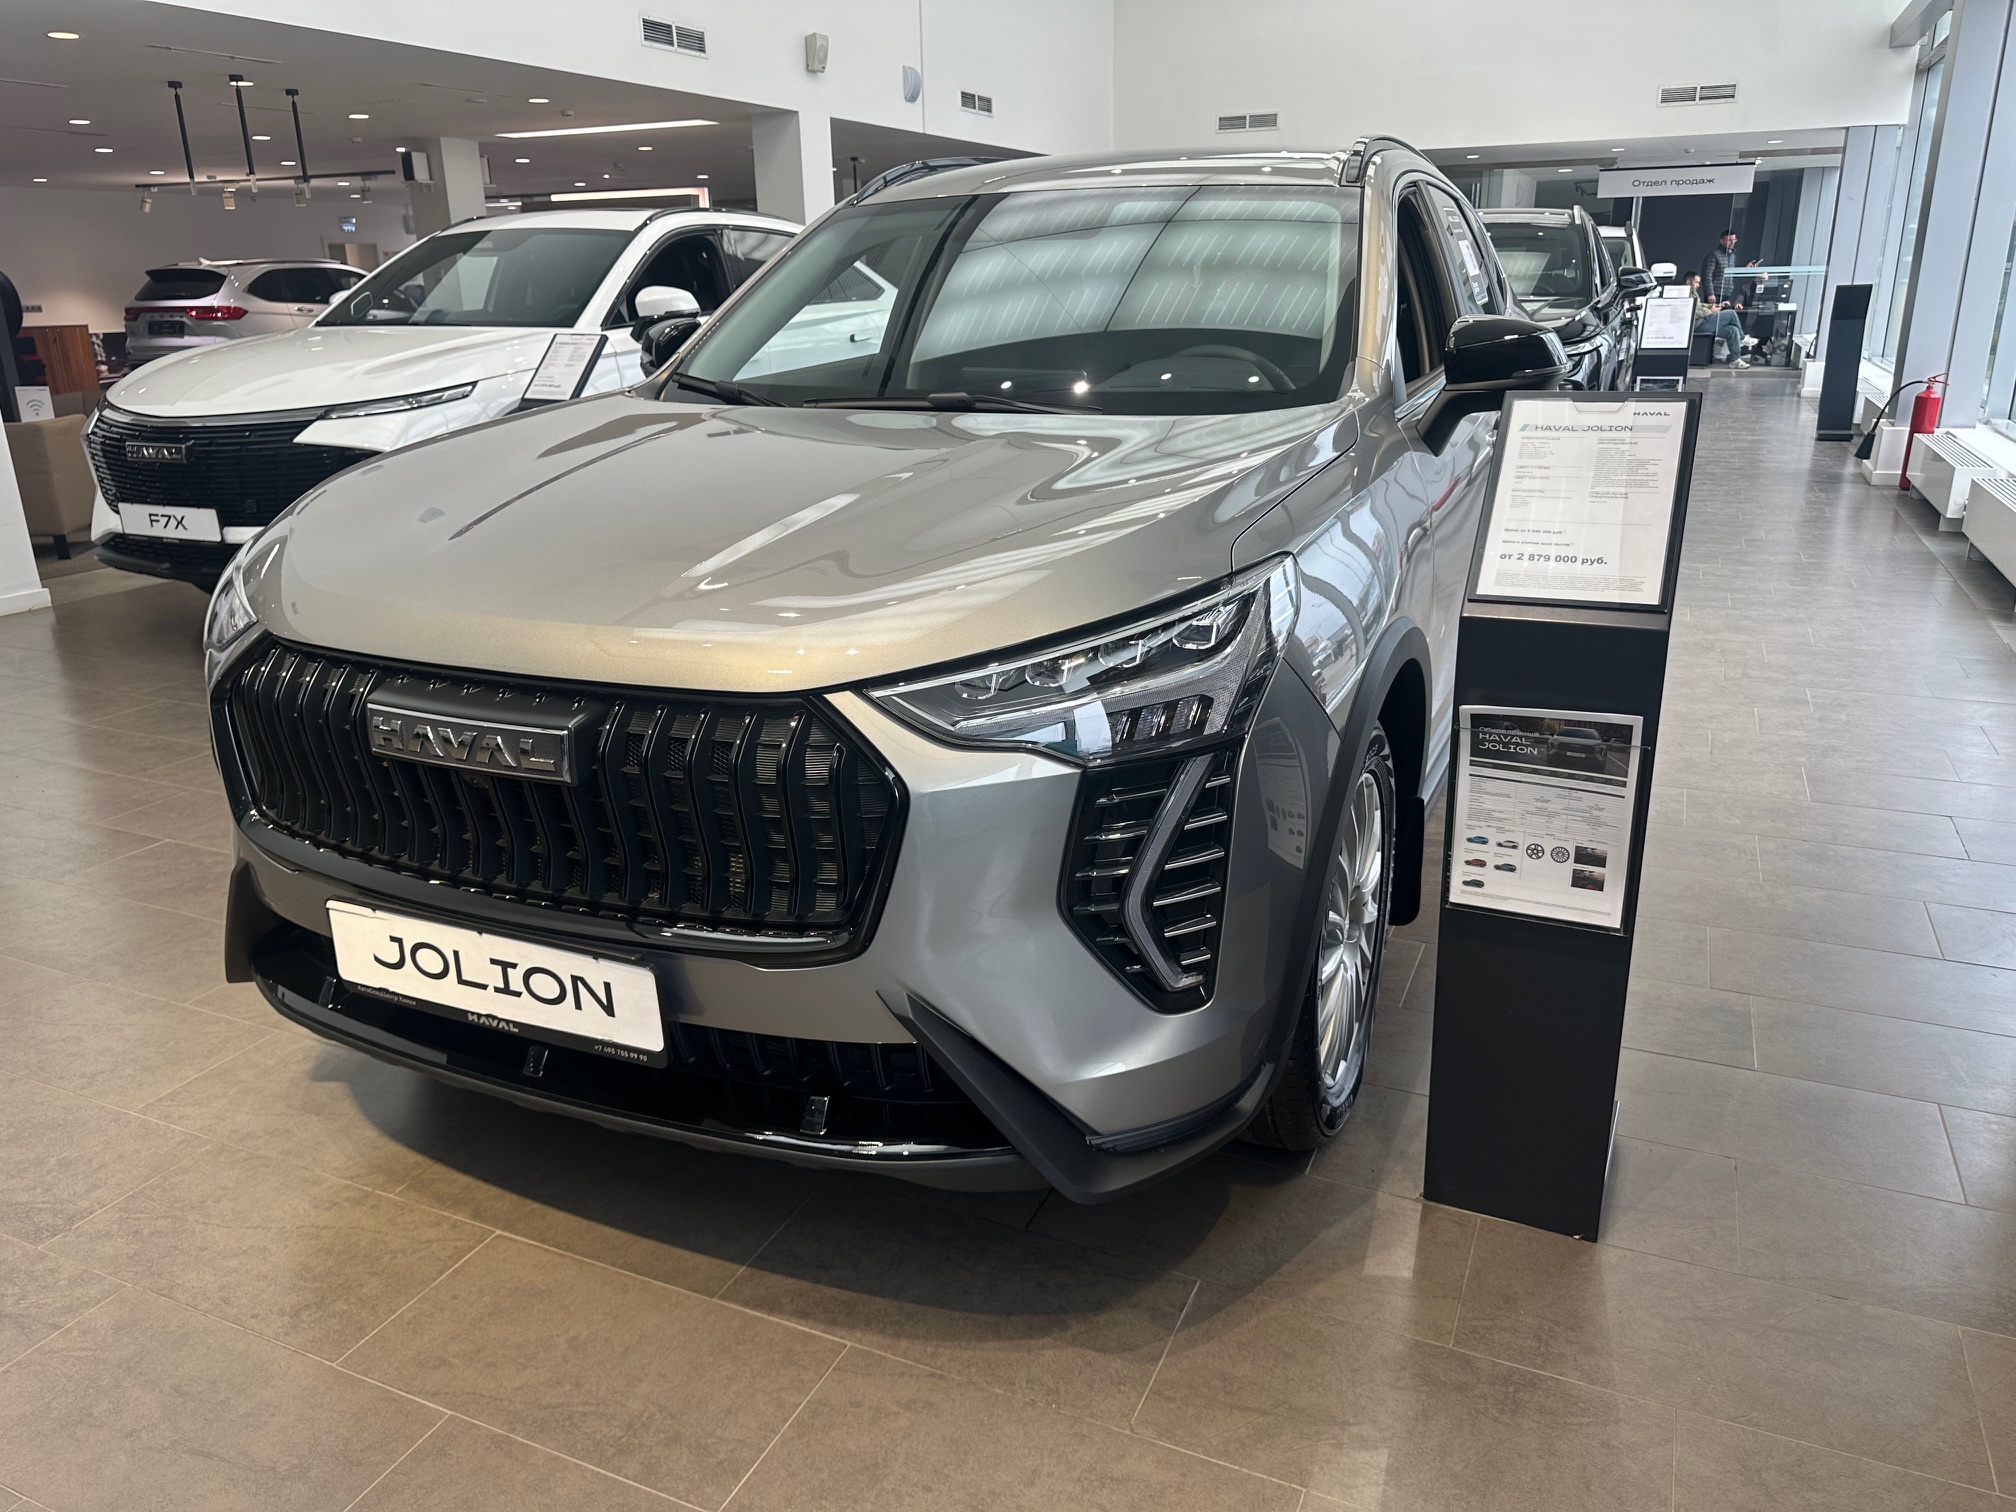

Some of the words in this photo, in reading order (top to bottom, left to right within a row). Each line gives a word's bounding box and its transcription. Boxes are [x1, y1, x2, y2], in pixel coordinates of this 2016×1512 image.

[1632, 179, 1667, 187] Отдел
[1670, 178, 1715, 187] продаж
[148, 513, 188, 531] F7X
[1516, 552, 1525, 560] 2
[1528, 553, 1551, 562] 879
[1554, 554, 1578, 563] 000
[1581, 556, 1608, 566] руб.
[371, 716, 557, 772] HAVAL
[1479, 733, 1531, 744] HAVAL
[1479, 742, 1538, 755] JOLION
[373, 935, 616, 1018] JOLION
[467, 1012, 519, 1032] HAVAL
[603, 1046, 615, 1055] 495
[616, 1049, 629, 1057] 755
